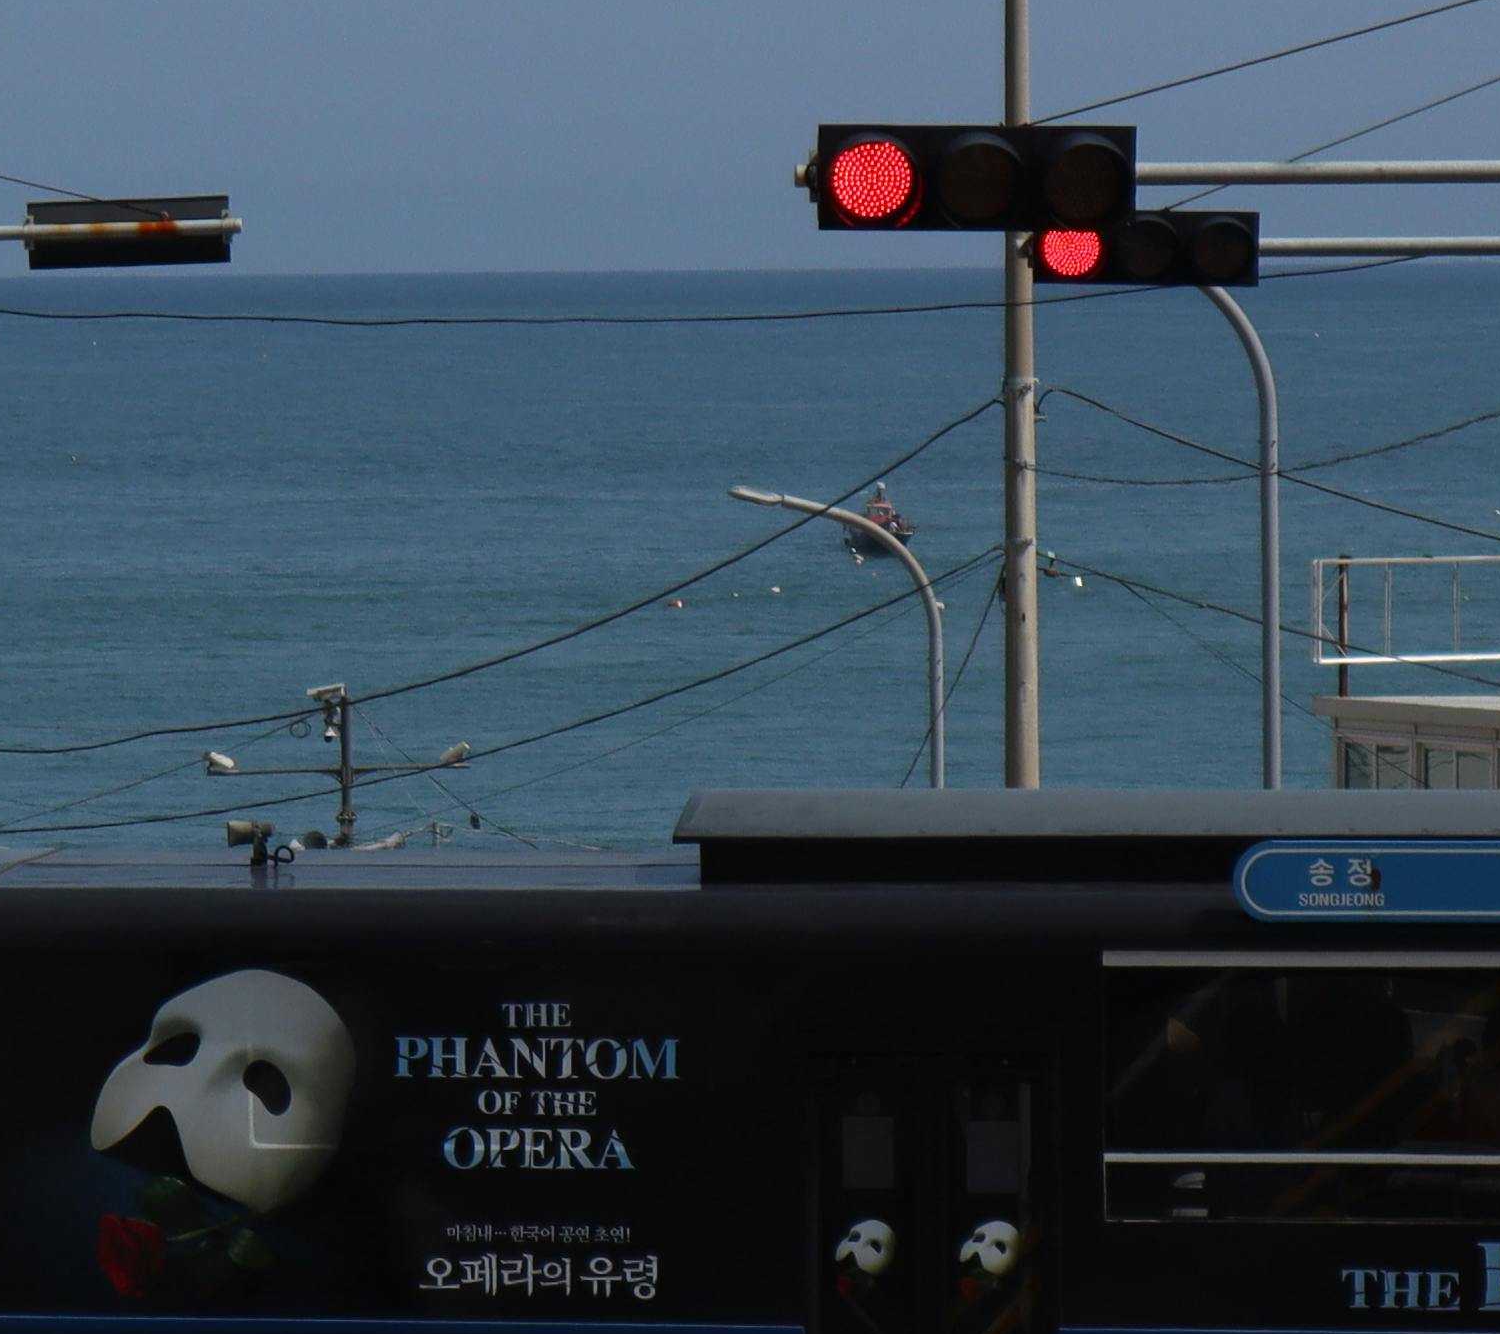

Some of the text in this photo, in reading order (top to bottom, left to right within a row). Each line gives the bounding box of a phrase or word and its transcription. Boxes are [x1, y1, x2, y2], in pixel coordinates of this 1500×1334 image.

[1308, 858, 1374, 888] 송정
[1298, 893, 1385, 908] SONGJEONG
[502, 1002, 572, 1028] THE
[393, 1035, 681, 1080] PHANTOM
[477, 1090, 598, 1117] OF THE
[442, 1126, 637, 1170] OPERA
[509, 1223, 556, 1243] 한국어
[559, 1223, 590, 1243] 공연
[418, 1251, 660, 1300] 오페라의 유령
[1341, 1268, 1460, 1312] THE
